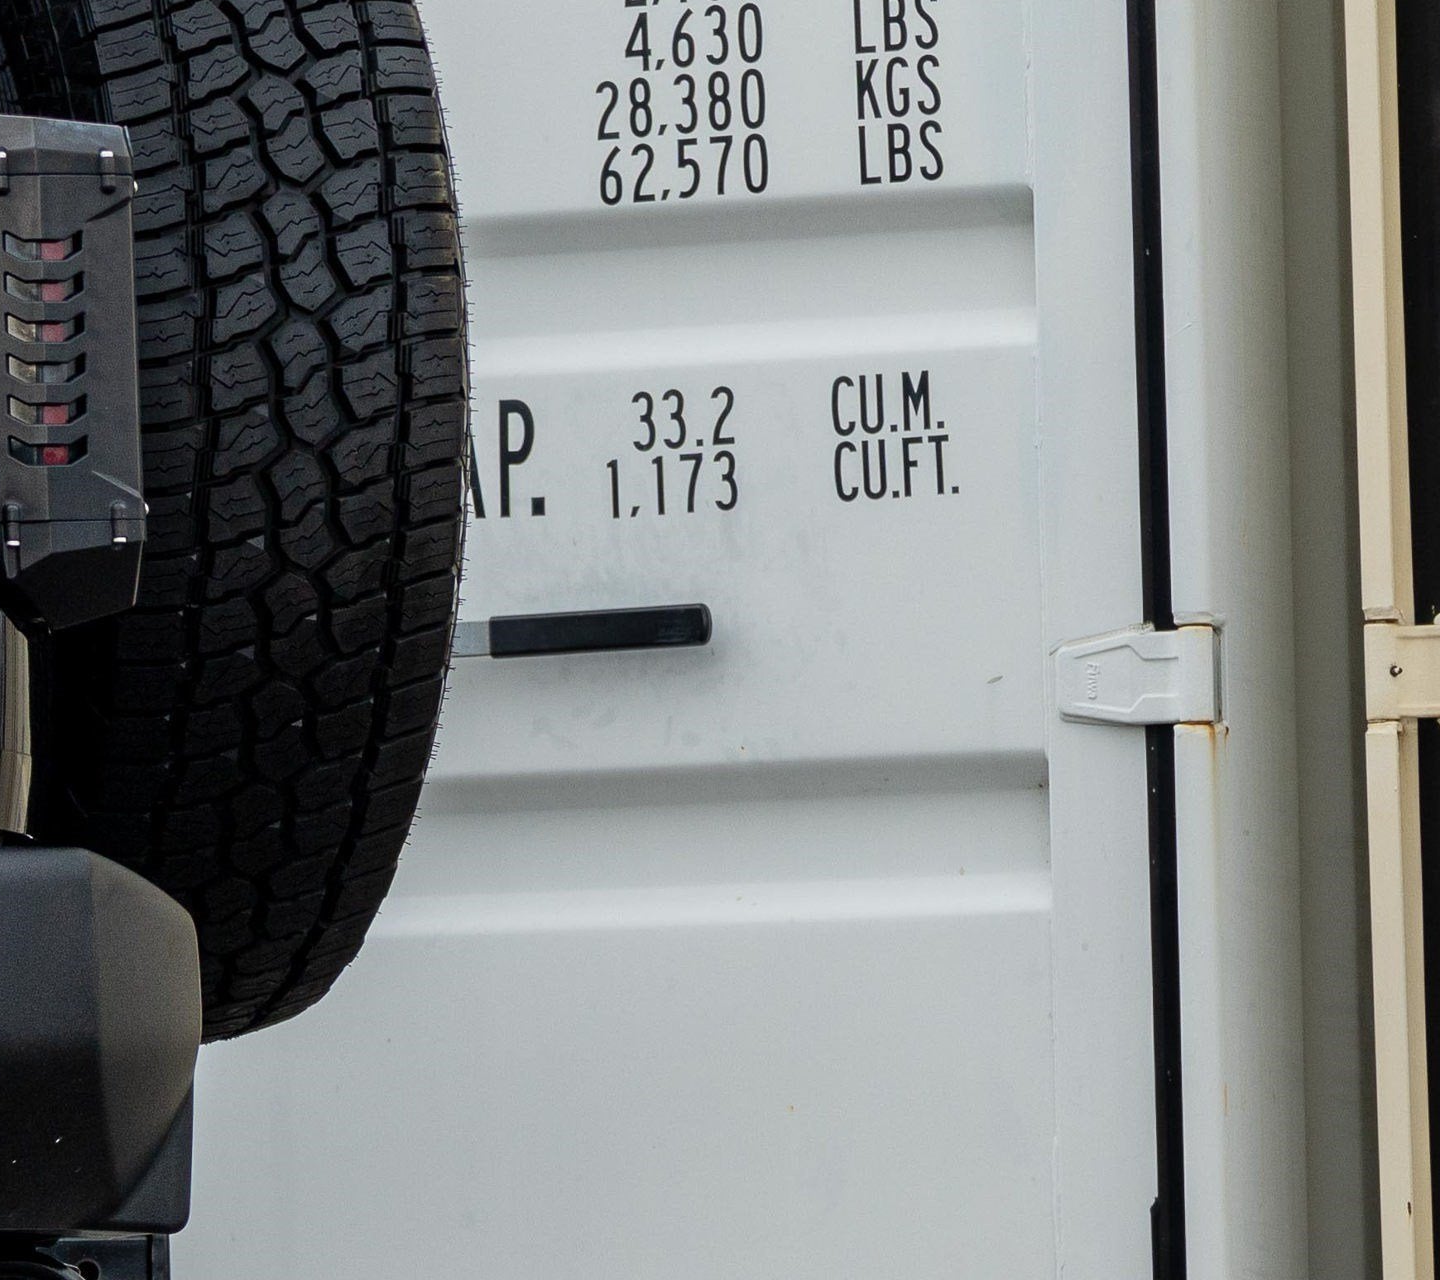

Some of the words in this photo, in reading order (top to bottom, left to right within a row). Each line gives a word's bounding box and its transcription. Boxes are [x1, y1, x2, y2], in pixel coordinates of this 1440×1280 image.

[625, 2, 762, 71] 4,630
[596, 67, 765, 143] 28,380
[856, 55, 941, 119] KGS
[598, 132, 768, 205] 62,570
[859, 120, 943, 185] LBS
[632, 386, 734, 451] 33.2
[832, 371, 948, 437] CU.M.
[607, 448, 737, 518] 1,173
[835, 433, 959, 502] CU.FT.
